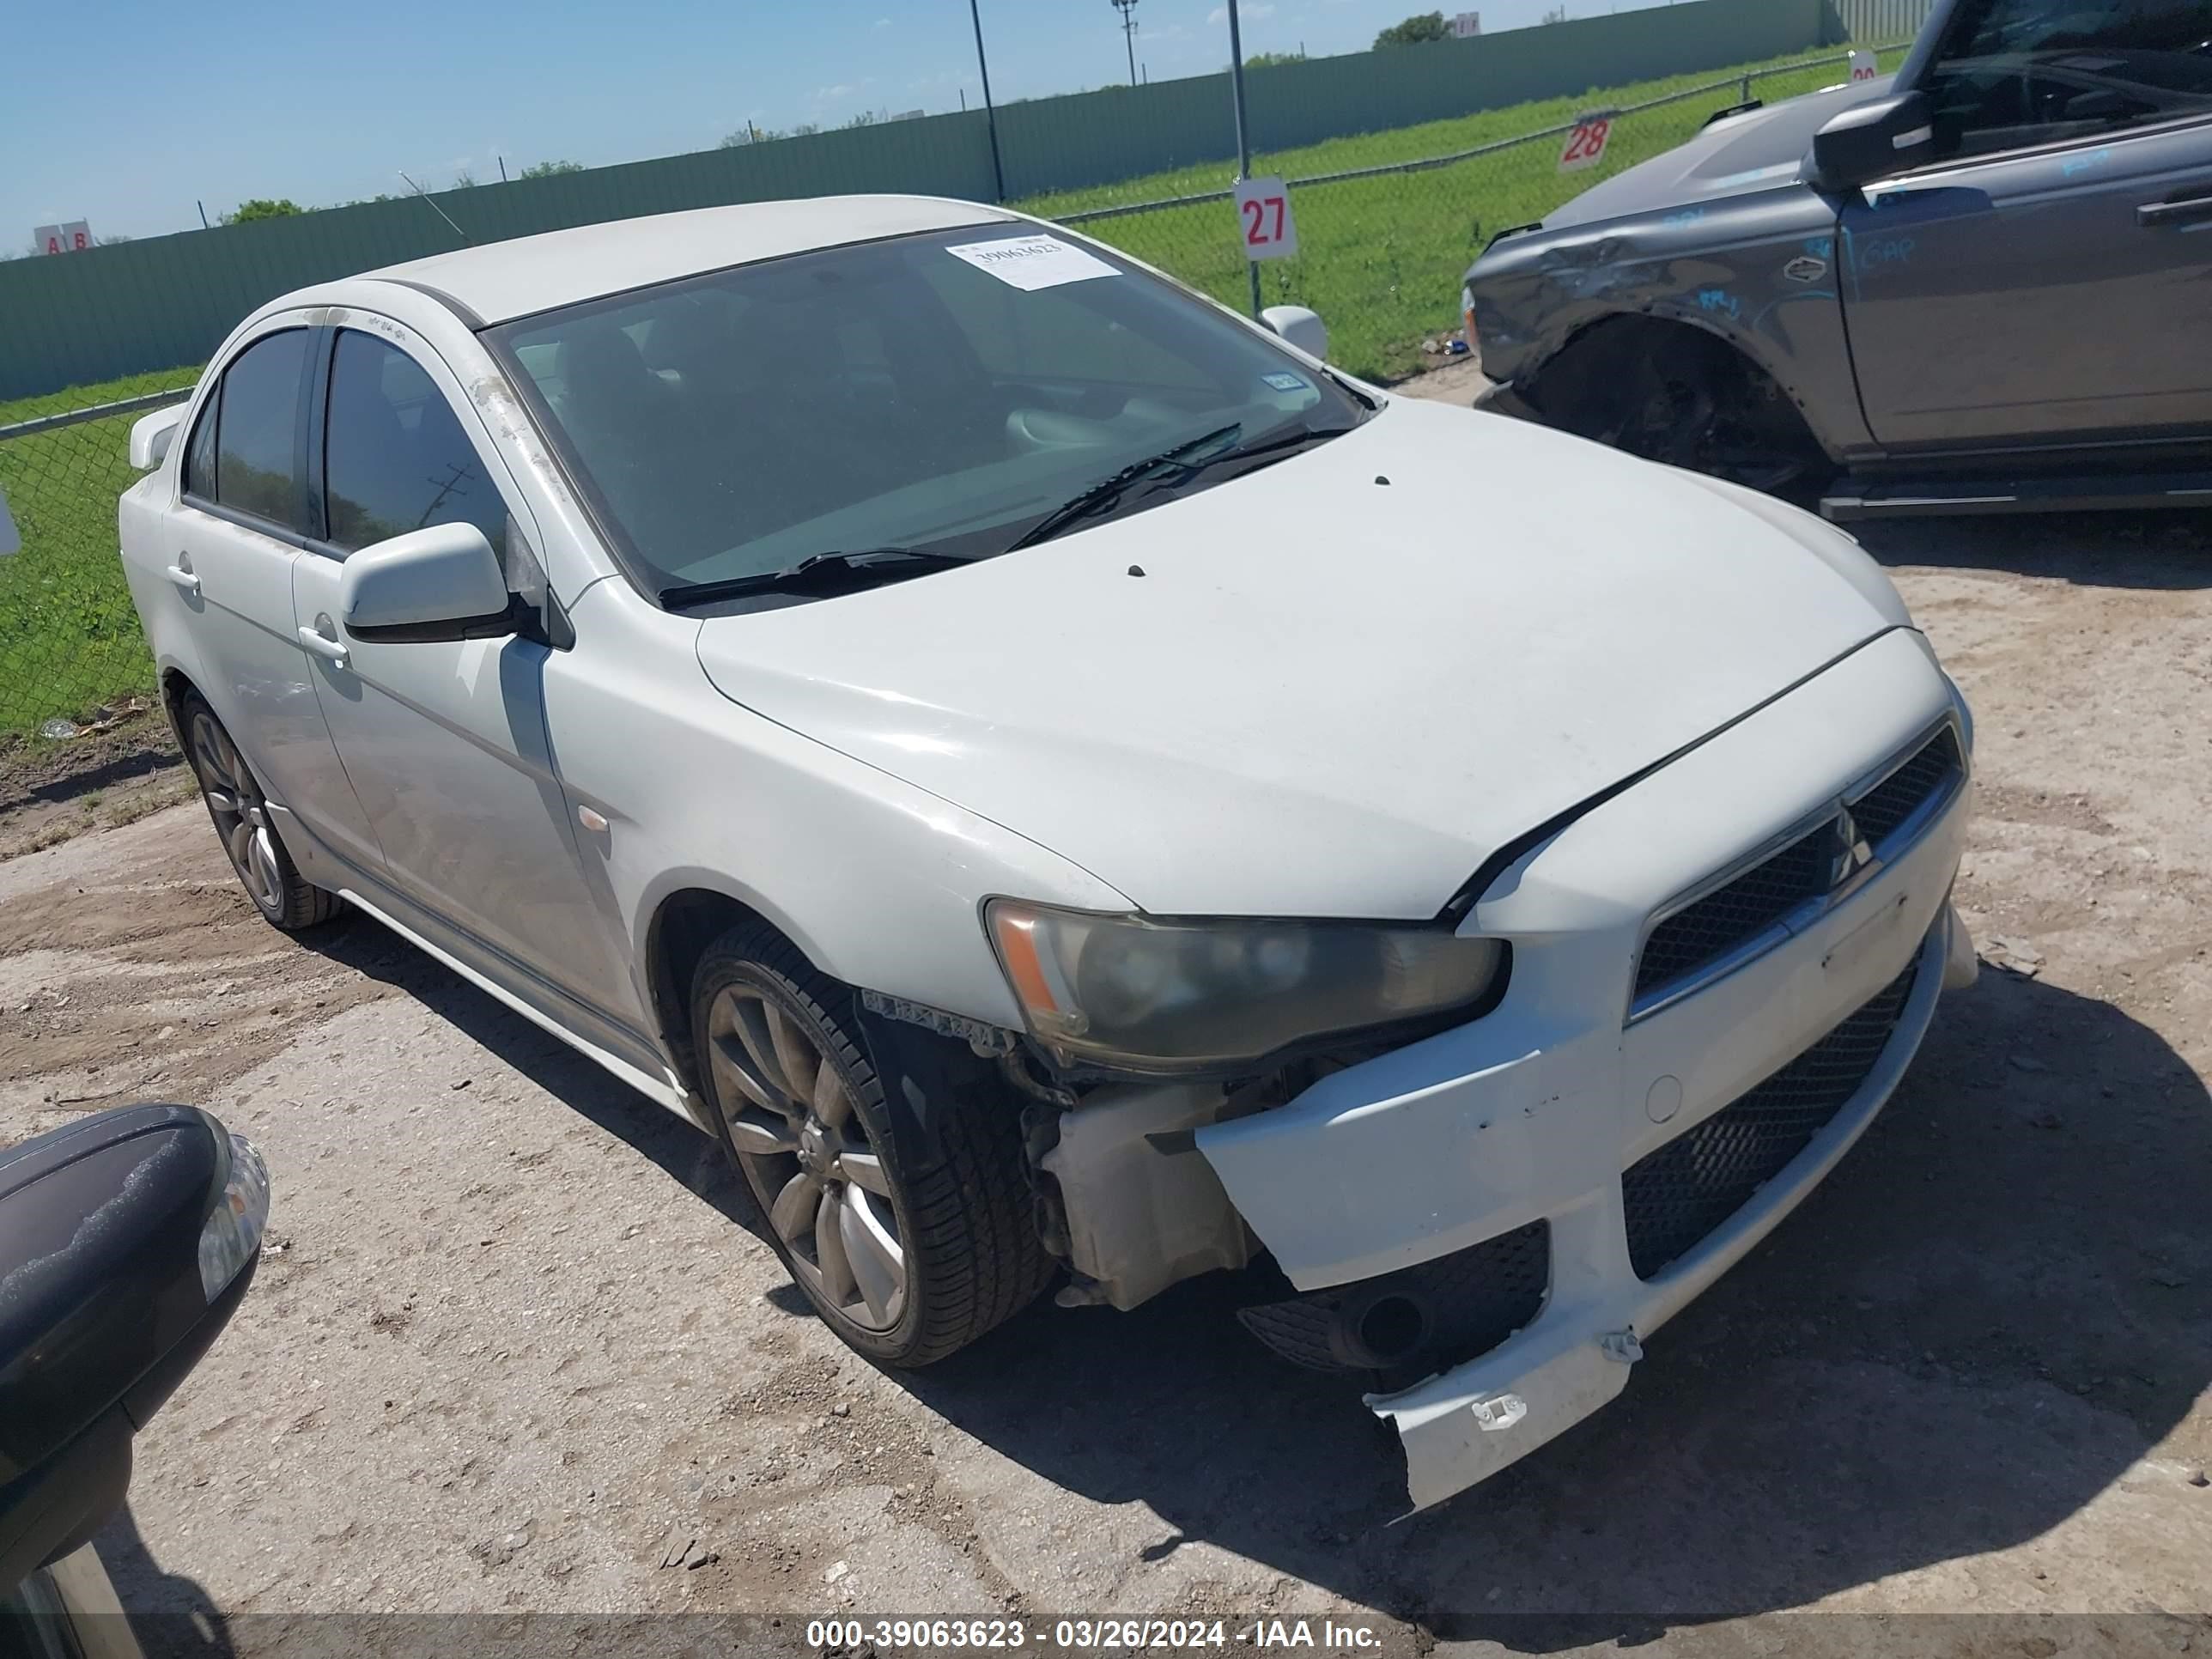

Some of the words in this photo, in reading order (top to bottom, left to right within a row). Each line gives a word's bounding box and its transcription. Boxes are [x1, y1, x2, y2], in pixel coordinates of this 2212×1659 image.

[1564, 119, 1607, 162] 28
[1243, 197, 1284, 246] 27
[48, 236, 60, 255] A
[975, 244, 1063, 264] 39063623
